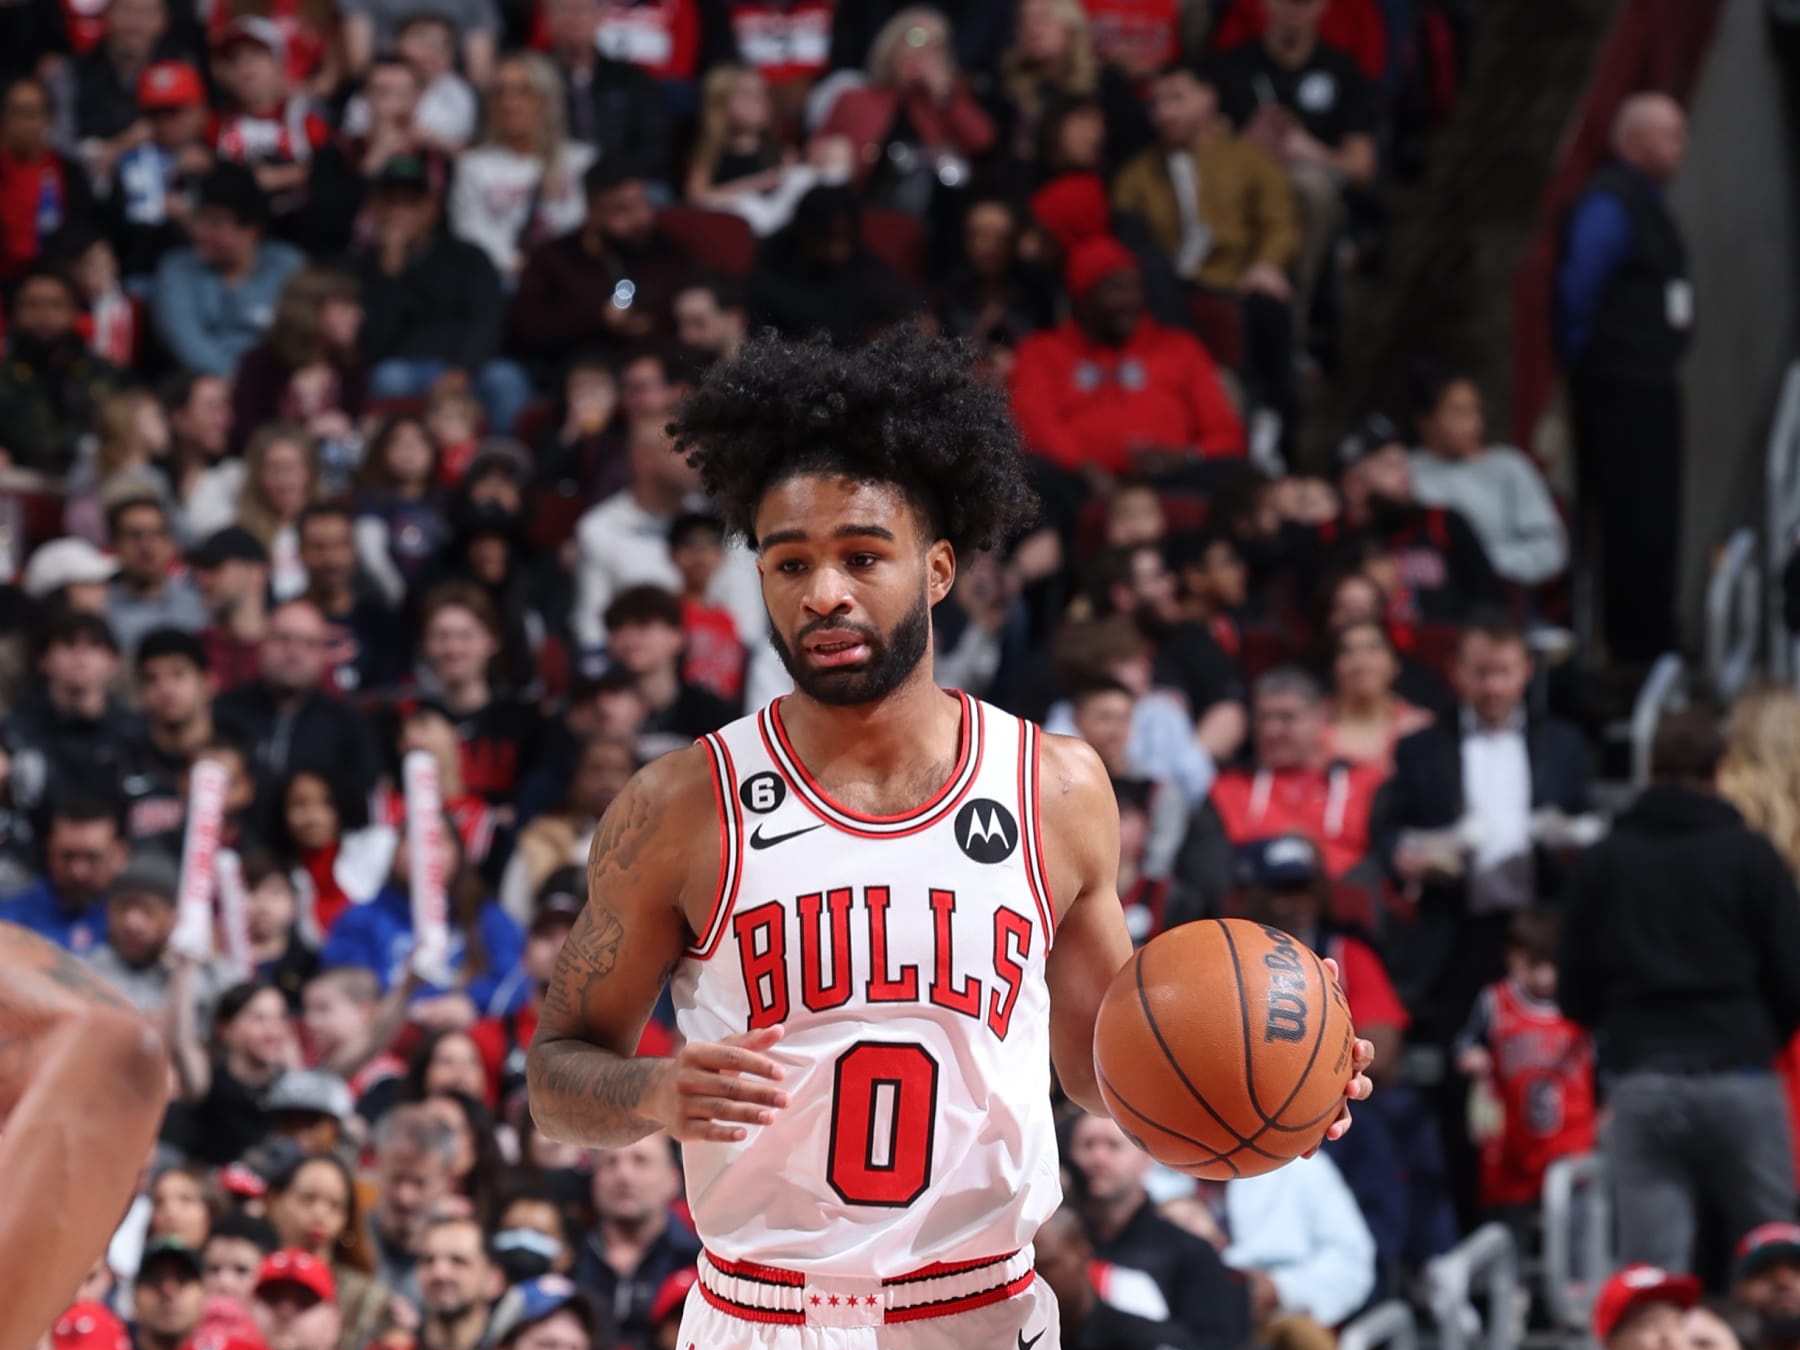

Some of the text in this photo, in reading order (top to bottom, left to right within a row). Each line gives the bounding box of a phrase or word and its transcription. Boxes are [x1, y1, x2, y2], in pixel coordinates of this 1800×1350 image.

[751, 776, 776, 810] 6
[733, 886, 1033, 1042] BULLS
[827, 1040, 939, 1208] 0
